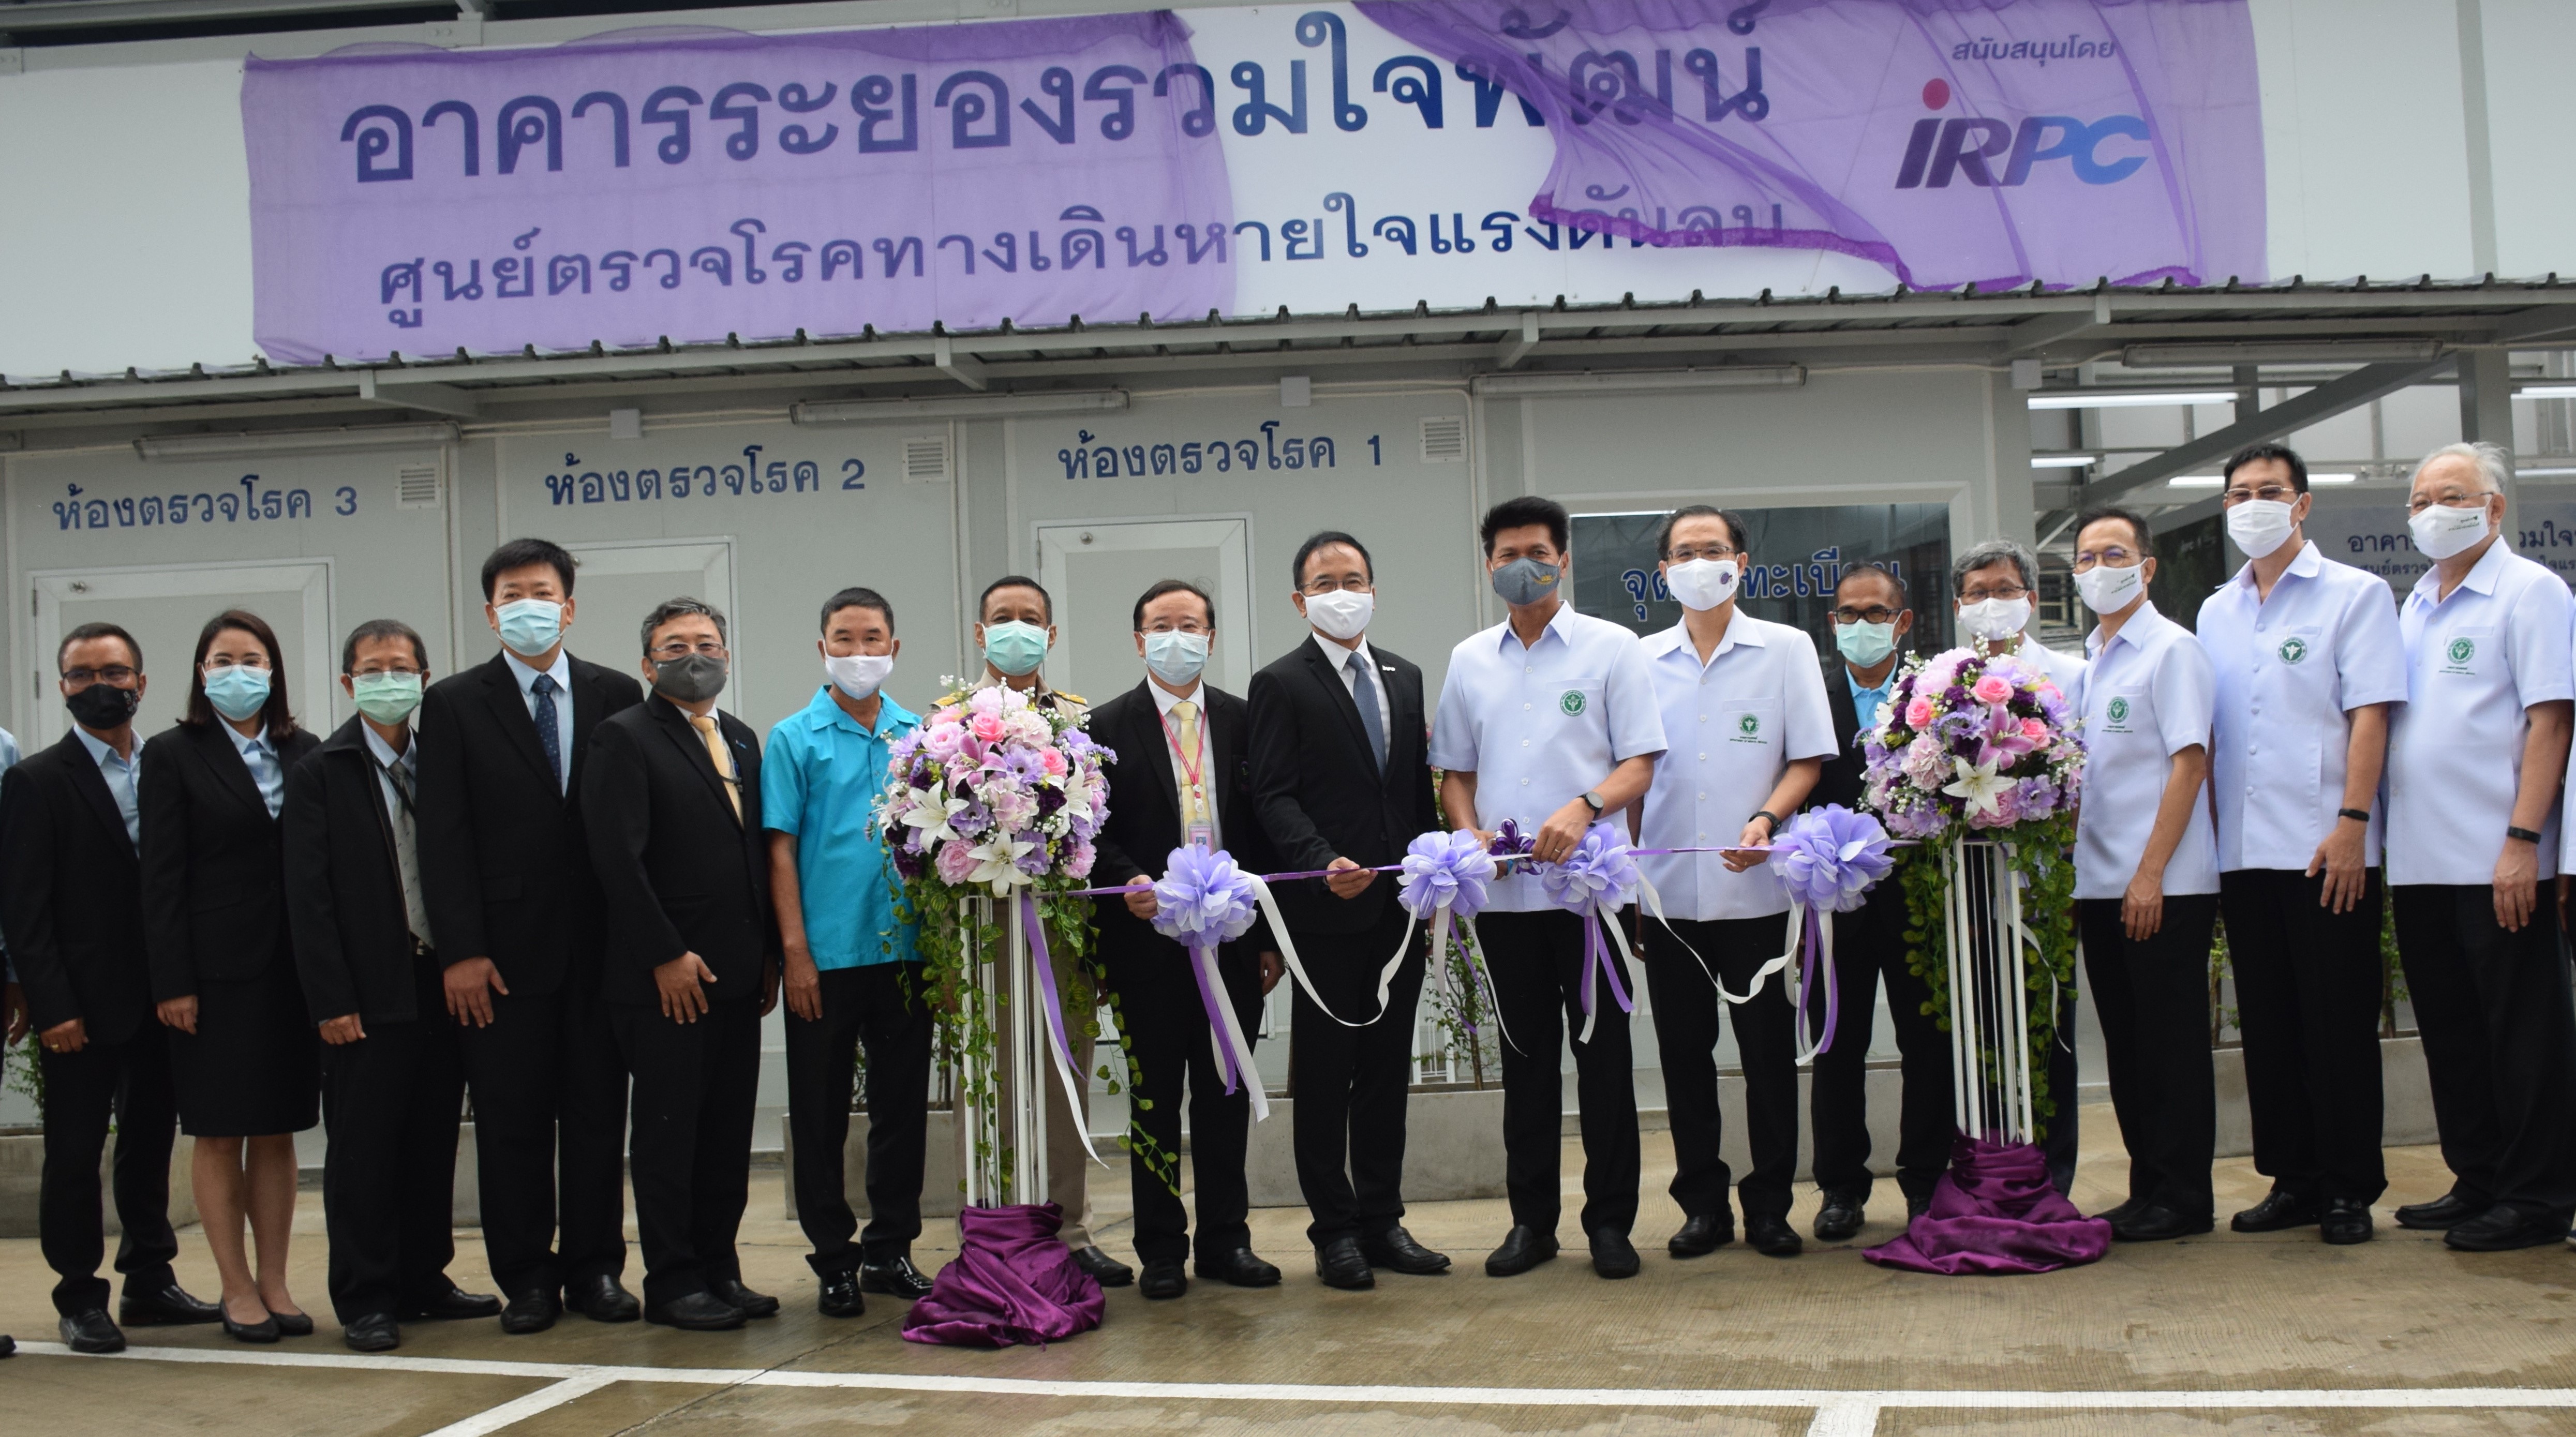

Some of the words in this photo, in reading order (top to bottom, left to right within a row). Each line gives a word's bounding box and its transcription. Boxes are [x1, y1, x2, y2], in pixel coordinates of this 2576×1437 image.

[1952, 34, 2117, 67] สนับสนุนโดย
[340, 0, 1771, 183] อาคารระยองรวมใจพัฒน์
[381, 184, 1782, 328] ศูนย์ตรวจโรคทางเดินหายใจแรงดันลบ
[545, 445, 819, 505] ห้องตรวจโรค
[841, 458, 866, 490] 2
[1058, 421, 1335, 480] ห้องตรวจโรค
[1367, 435, 1381, 466] 1
[53, 474, 311, 530] ห้องตรวจโรค
[335, 487, 357, 516] 3
